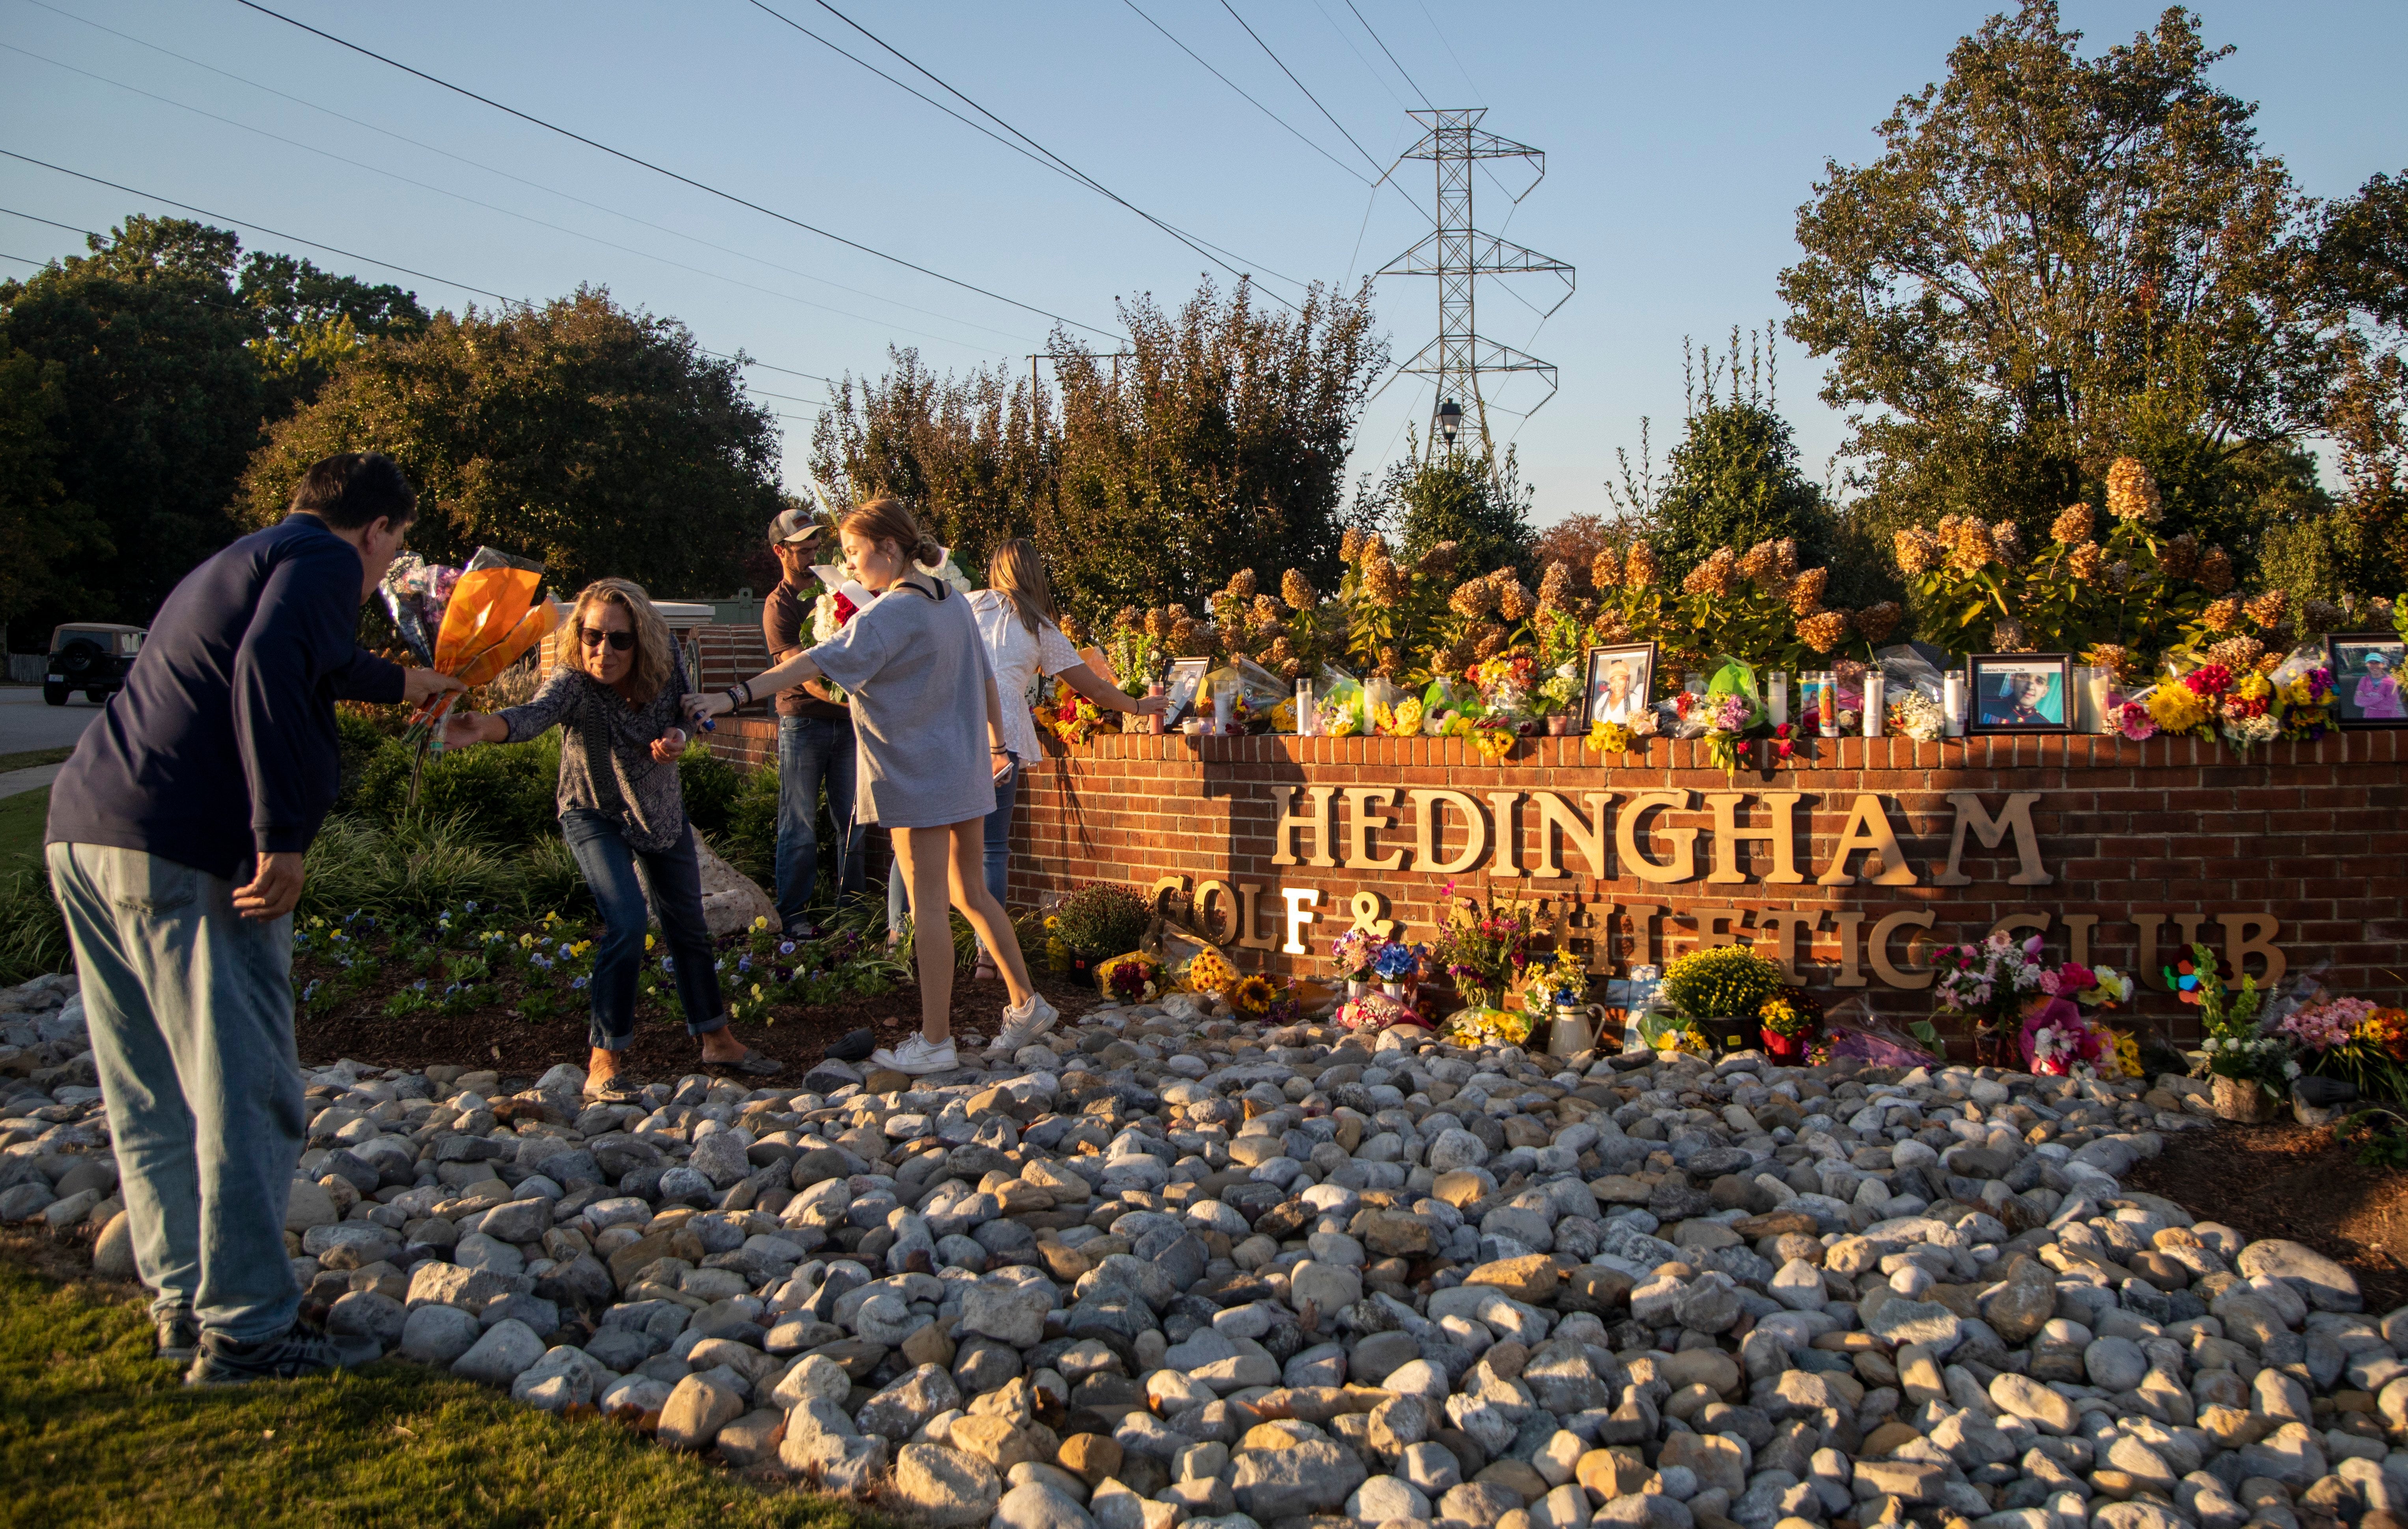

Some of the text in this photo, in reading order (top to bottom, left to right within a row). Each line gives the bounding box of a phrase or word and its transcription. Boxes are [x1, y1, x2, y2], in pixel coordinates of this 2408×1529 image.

[1271, 786, 2054, 885] HEDINGHAM
[1150, 874, 1320, 955] GOLF
[1346, 891, 1394, 944] &
